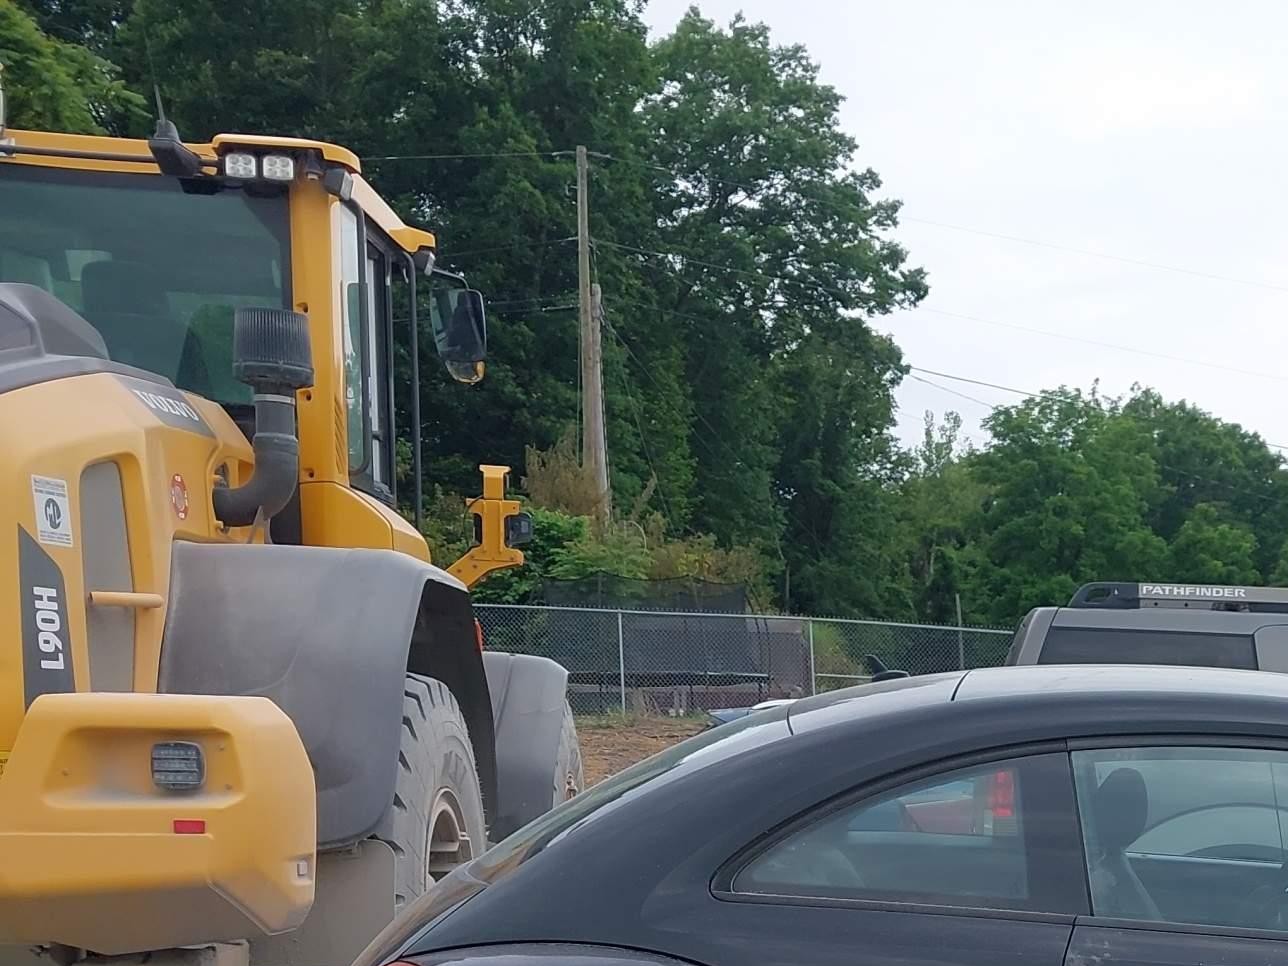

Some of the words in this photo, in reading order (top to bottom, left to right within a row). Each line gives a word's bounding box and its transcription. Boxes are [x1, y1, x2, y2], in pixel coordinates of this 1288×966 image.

[131, 389, 199, 421] VOLVO
[1142, 585, 1246, 597] PATHFINDER
[33, 586, 64, 669] L90H
